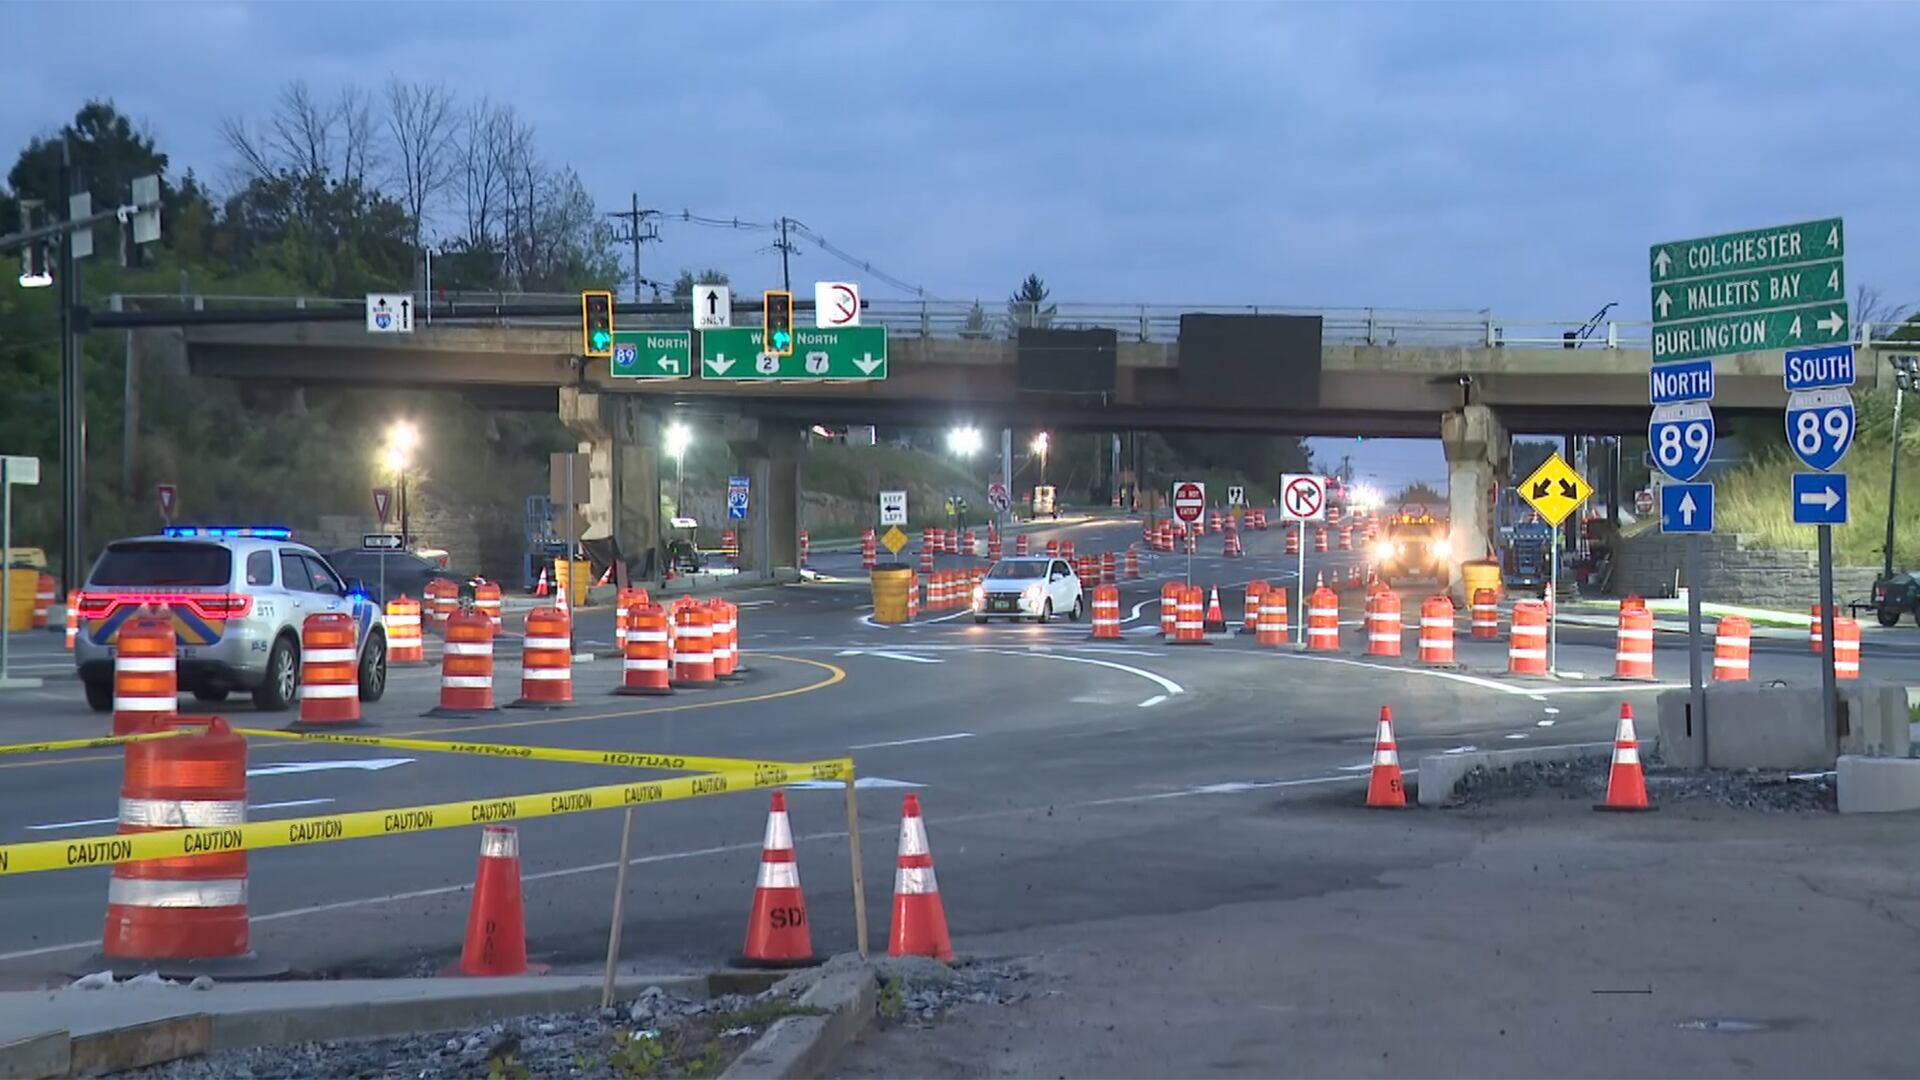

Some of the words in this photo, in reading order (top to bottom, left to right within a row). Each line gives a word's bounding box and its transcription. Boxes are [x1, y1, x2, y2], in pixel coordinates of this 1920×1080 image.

[1689, 232, 1801, 269] COLCHESTER
[1827, 226, 1839, 249] 4
[1688, 279, 1760, 311] MALLETTS
[1770, 274, 1800, 300] BAY
[1827, 268, 1839, 291] 4
[647, 336, 687, 349] NORTH
[797, 332, 838, 345] NORTH
[1655, 320, 1766, 356] BURLINGTON
[1789, 315, 1802, 339] 4
[616, 349, 634, 364] 89
[763, 356, 772, 370] 2
[813, 356, 822, 371] 7
[1789, 354, 1850, 383] SOUTH
[1653, 370, 1710, 399] NORTH
[1659, 422, 1709, 467] 89
[1797, 408, 1849, 456] 89
[257, 606, 275, 617] 911
[67, 841, 132, 864] CAUTION
[184, 830, 242, 853] CAUTION
[289, 819, 342, 842] CAUTION
[385, 810, 433, 832] CAUTION
[471, 800, 516, 822] CAUTION
[551, 793, 592, 812] CAUTION
[624, 785, 662, 803] CAUTION
[691, 776, 727, 795] CAUTION
